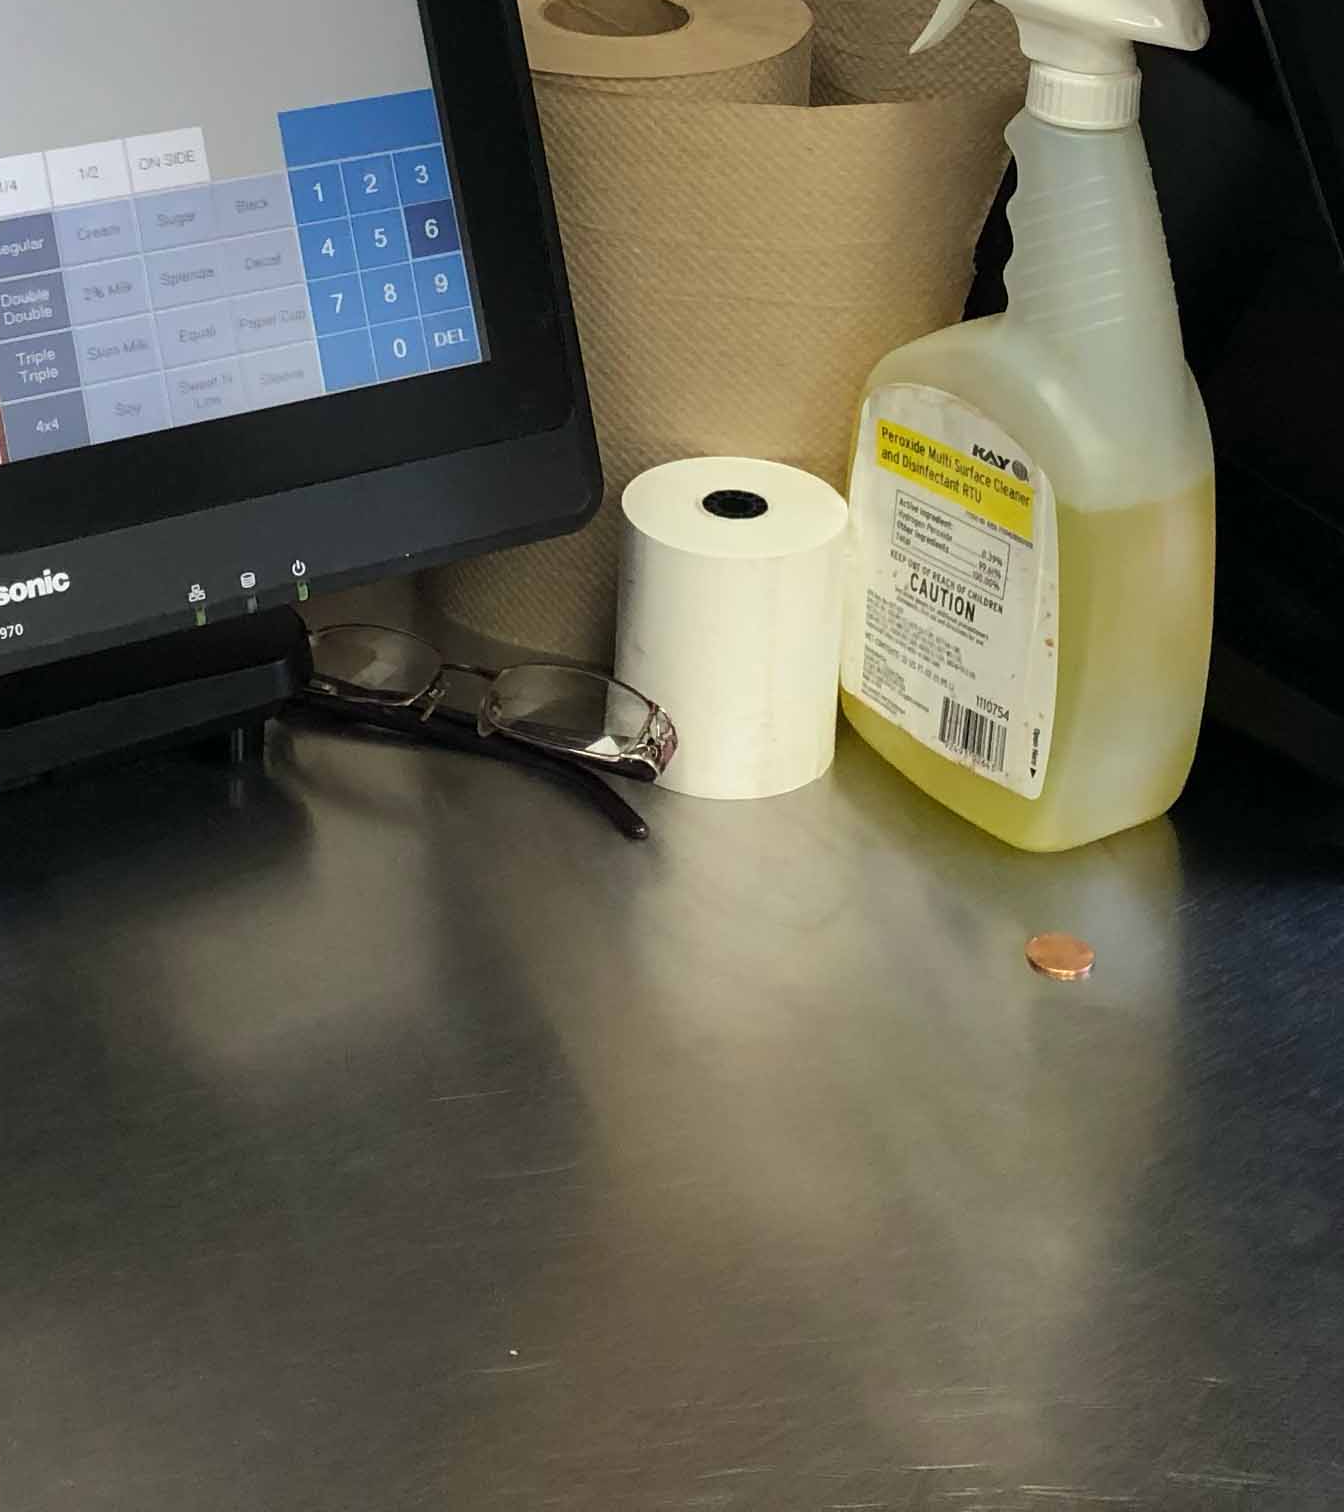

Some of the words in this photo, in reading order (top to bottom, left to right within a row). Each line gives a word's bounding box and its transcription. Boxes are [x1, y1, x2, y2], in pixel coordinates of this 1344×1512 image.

[313, 182, 324, 202] 1
[364, 174, 378, 194] 2
[415, 165, 429, 185] 3
[321, 237, 335, 258] 4
[374, 228, 388, 248] 5
[424, 219, 439, 239] 6
[0, 289, 51, 308] Double
[329, 293, 344, 313] 7
[383, 283, 397, 303] 8
[434, 273, 449, 294] 9
[4, 306, 54, 326] Double
[16, 346, 56, 368] Triple
[393, 338, 407, 359] 0
[433, 327, 470, 348] DEL
[19, 365, 60, 385] Triple
[881, 426, 926, 457] Peroxide
[928, 445, 953, 469] Multi
[955, 458, 992, 488] Surface
[993, 478, 1031, 507] Cleaner
[972, 442, 1010, 471] KAY
[881, 448, 900, 465] and
[902, 455, 960, 494] Disinfectant
[962, 483, 983, 504] RTU
[910, 572, 976, 623] CAUTION
[933, 571, 956, 590] REACH
[968, 590, 1004, 615] CHILDREN
